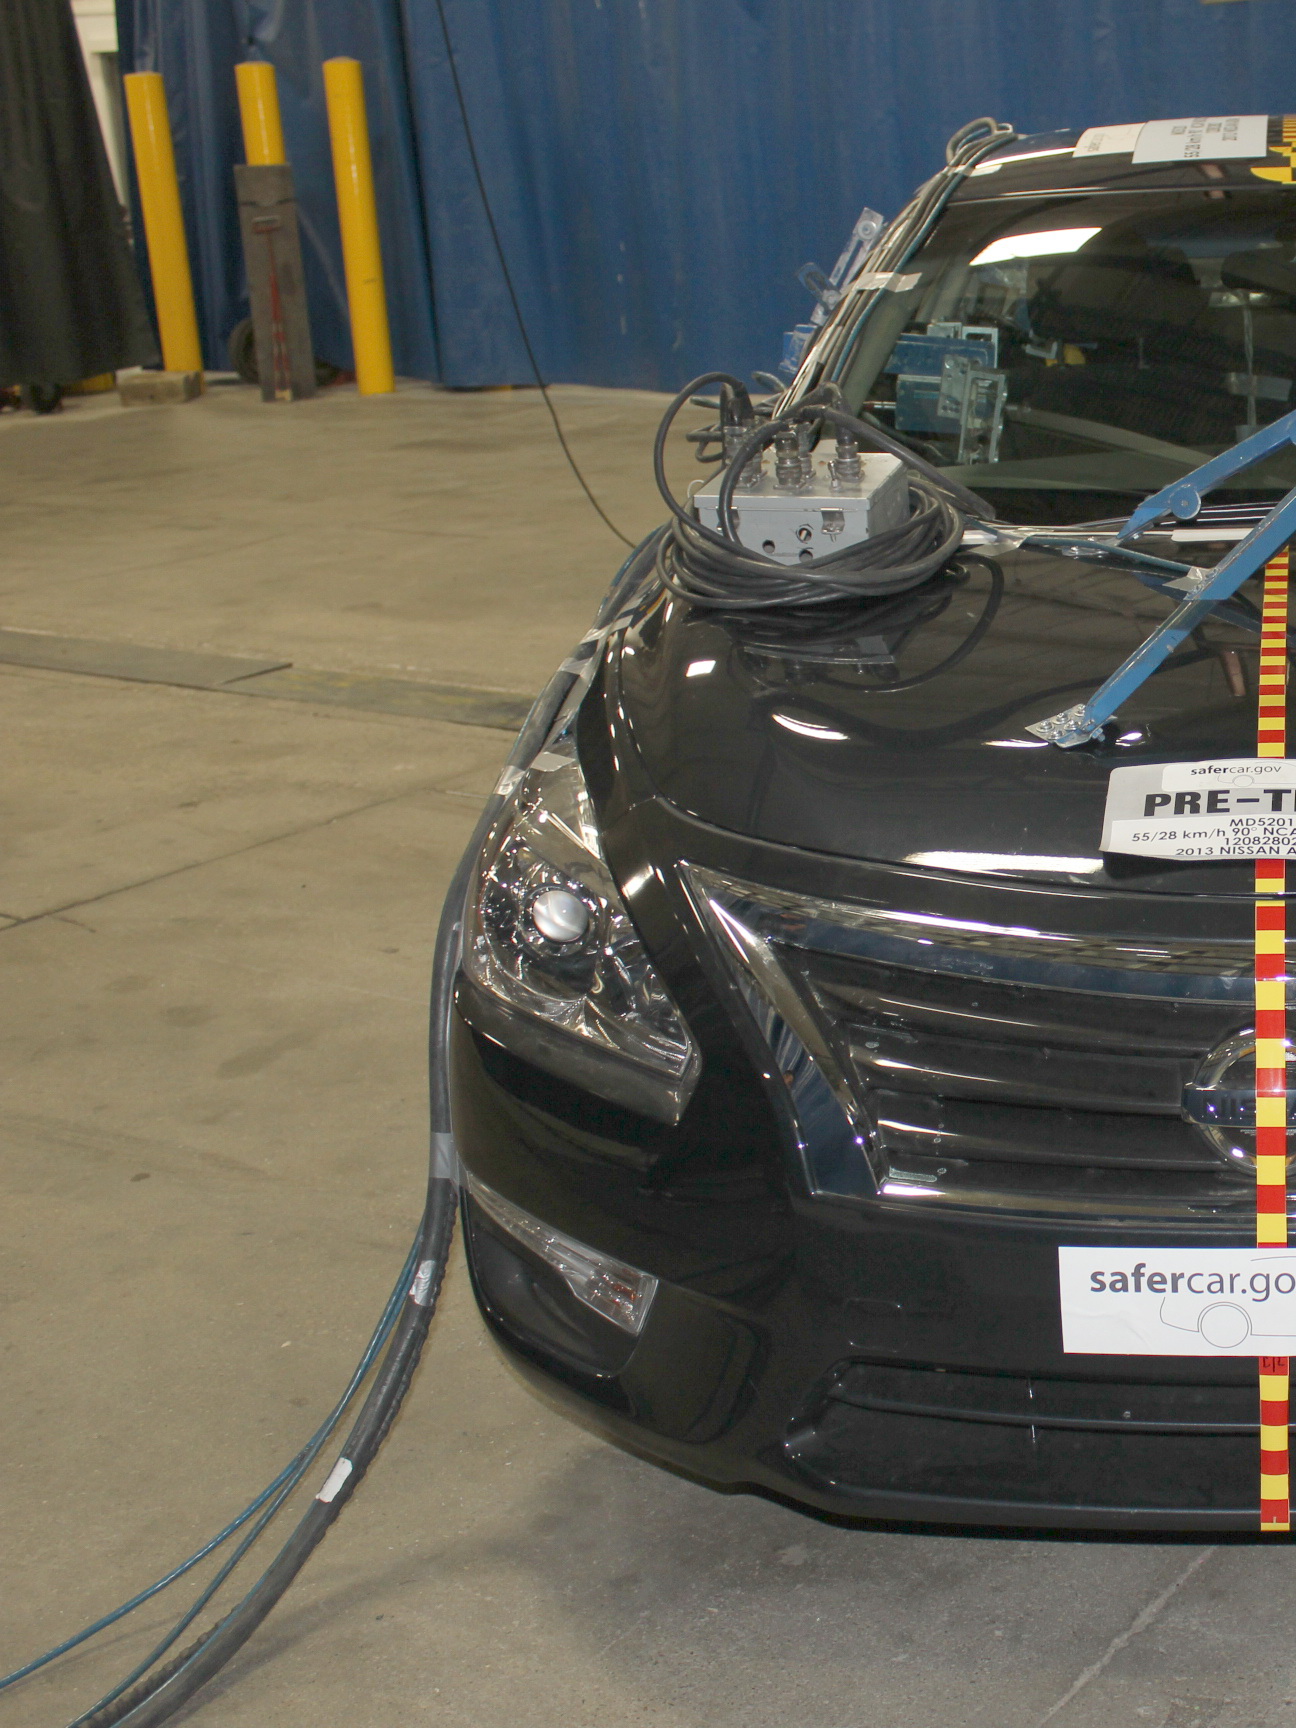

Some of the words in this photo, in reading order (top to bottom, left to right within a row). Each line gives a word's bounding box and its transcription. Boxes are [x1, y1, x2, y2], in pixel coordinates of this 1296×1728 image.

[1190, 764, 1282, 776] safercar.gov
[1229, 817, 1293, 827] MD5201
[1131, 830, 1177, 842] 55/28
[1182, 828, 1226, 839] km/h
[1175, 846, 1214, 856] 2013
[1219, 846, 1280, 855] NISSAN
